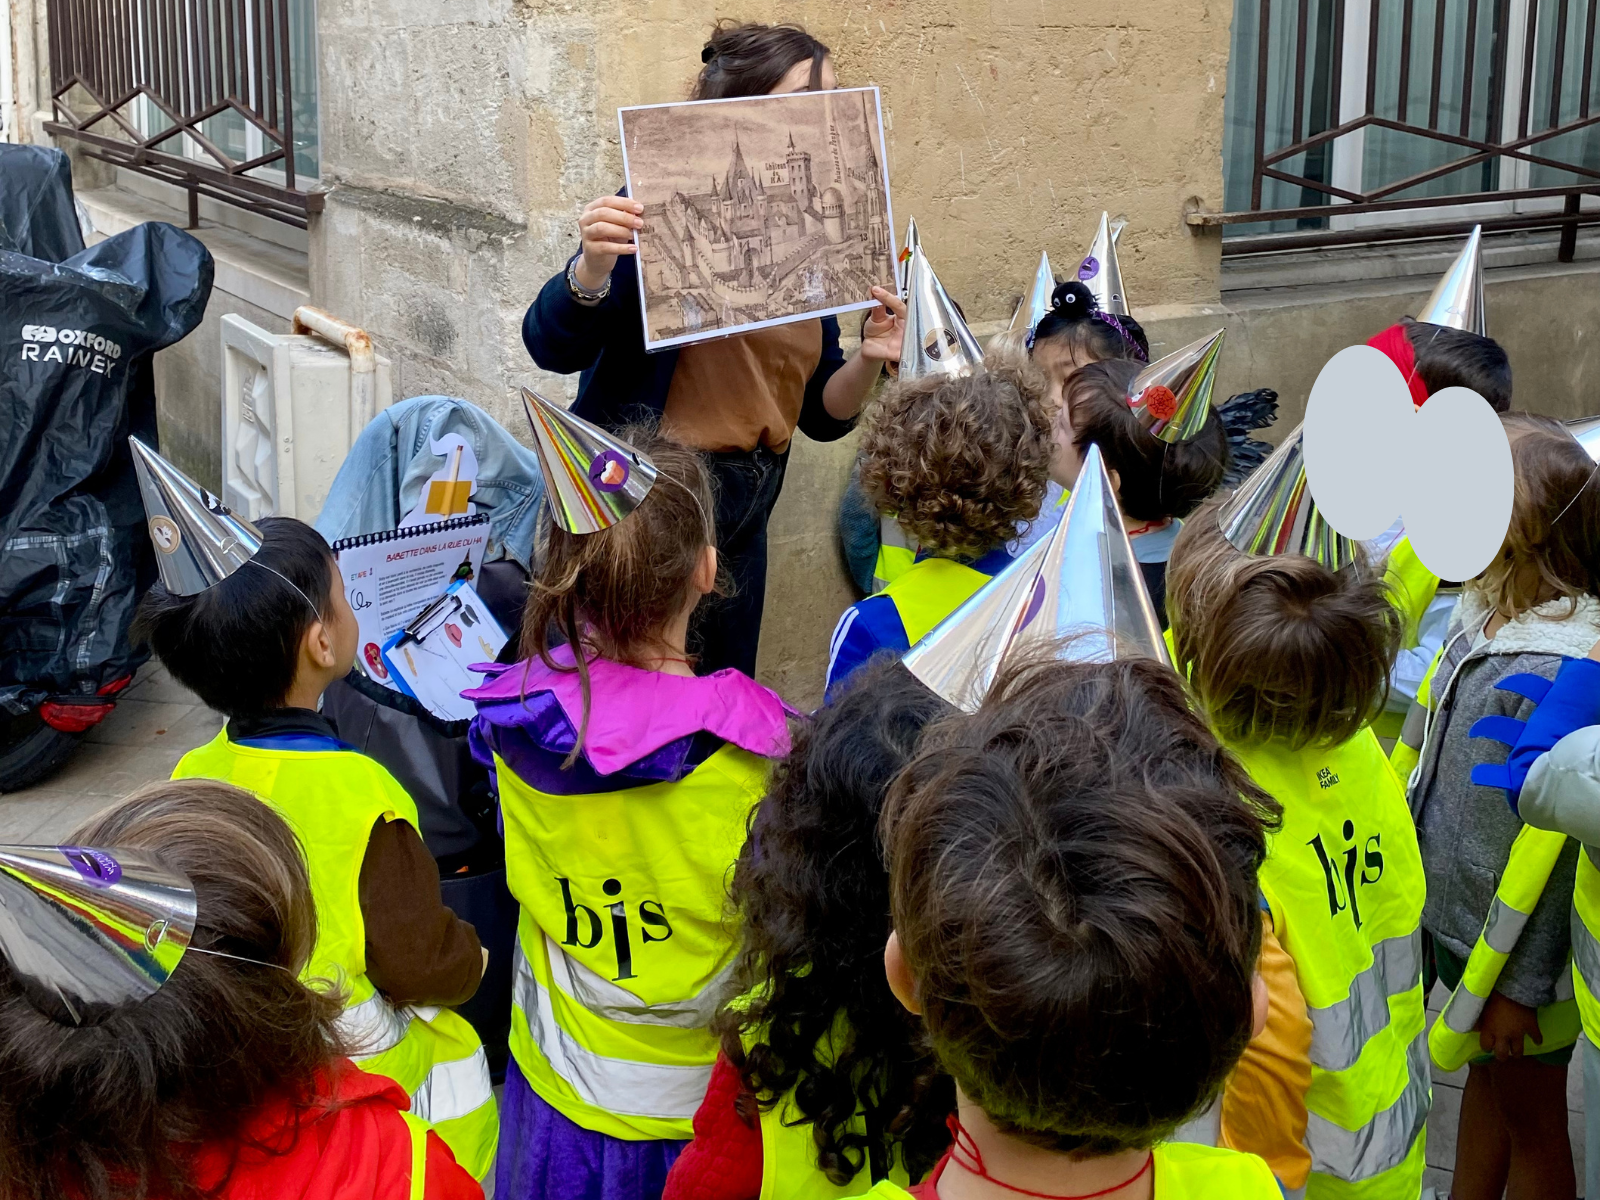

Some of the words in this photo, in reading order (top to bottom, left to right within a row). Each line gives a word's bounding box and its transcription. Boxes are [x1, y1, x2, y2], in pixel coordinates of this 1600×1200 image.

[58, 328, 121, 359] OXFORD
[21, 343, 116, 378] RAINEX
[386, 549, 419, 562] BABETTE
[420, 545, 437, 556] DANS
[438, 543, 447, 551] LA
[448, 540, 462, 549] RUE
[1316, 766, 1332, 782] IKEA
[1320, 773, 1340, 790] FAMILY
